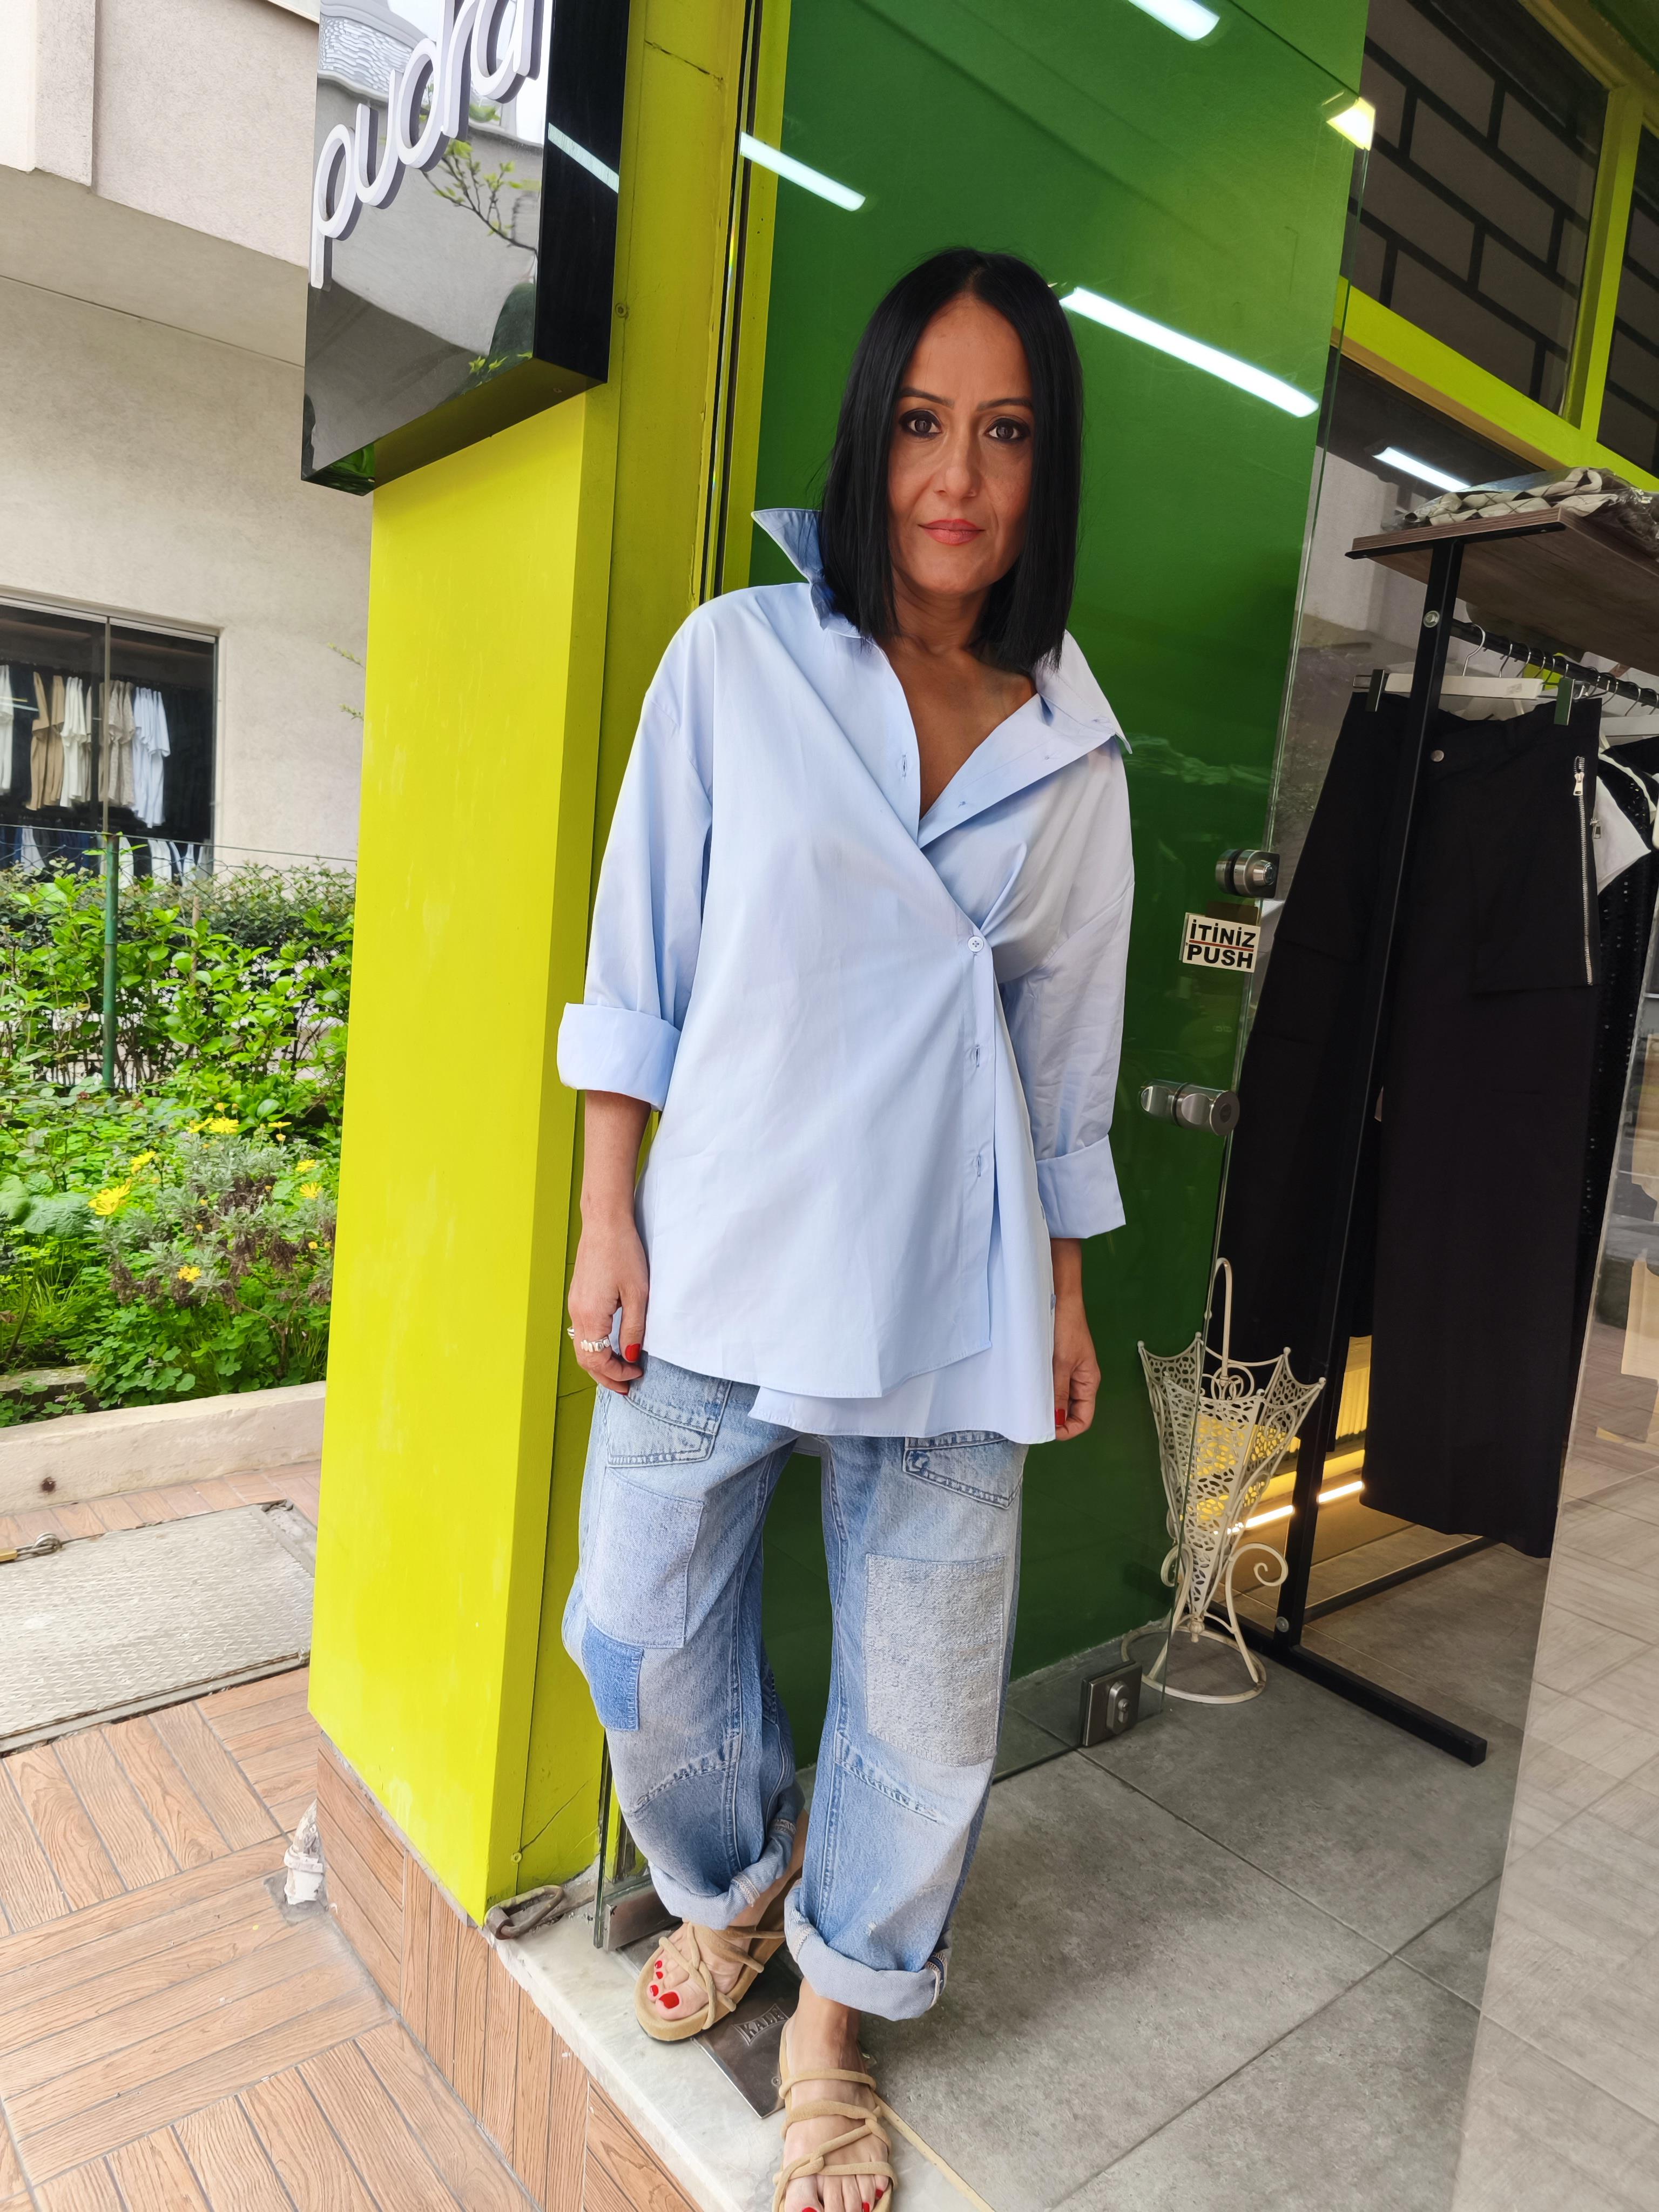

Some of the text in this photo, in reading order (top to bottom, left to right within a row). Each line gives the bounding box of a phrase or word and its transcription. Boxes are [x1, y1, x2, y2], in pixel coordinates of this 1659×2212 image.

[1190, 919, 1256, 948] İTİNİZ
[1187, 944, 1253, 969] PUSH
[735, 2007, 785, 2043] KALE
